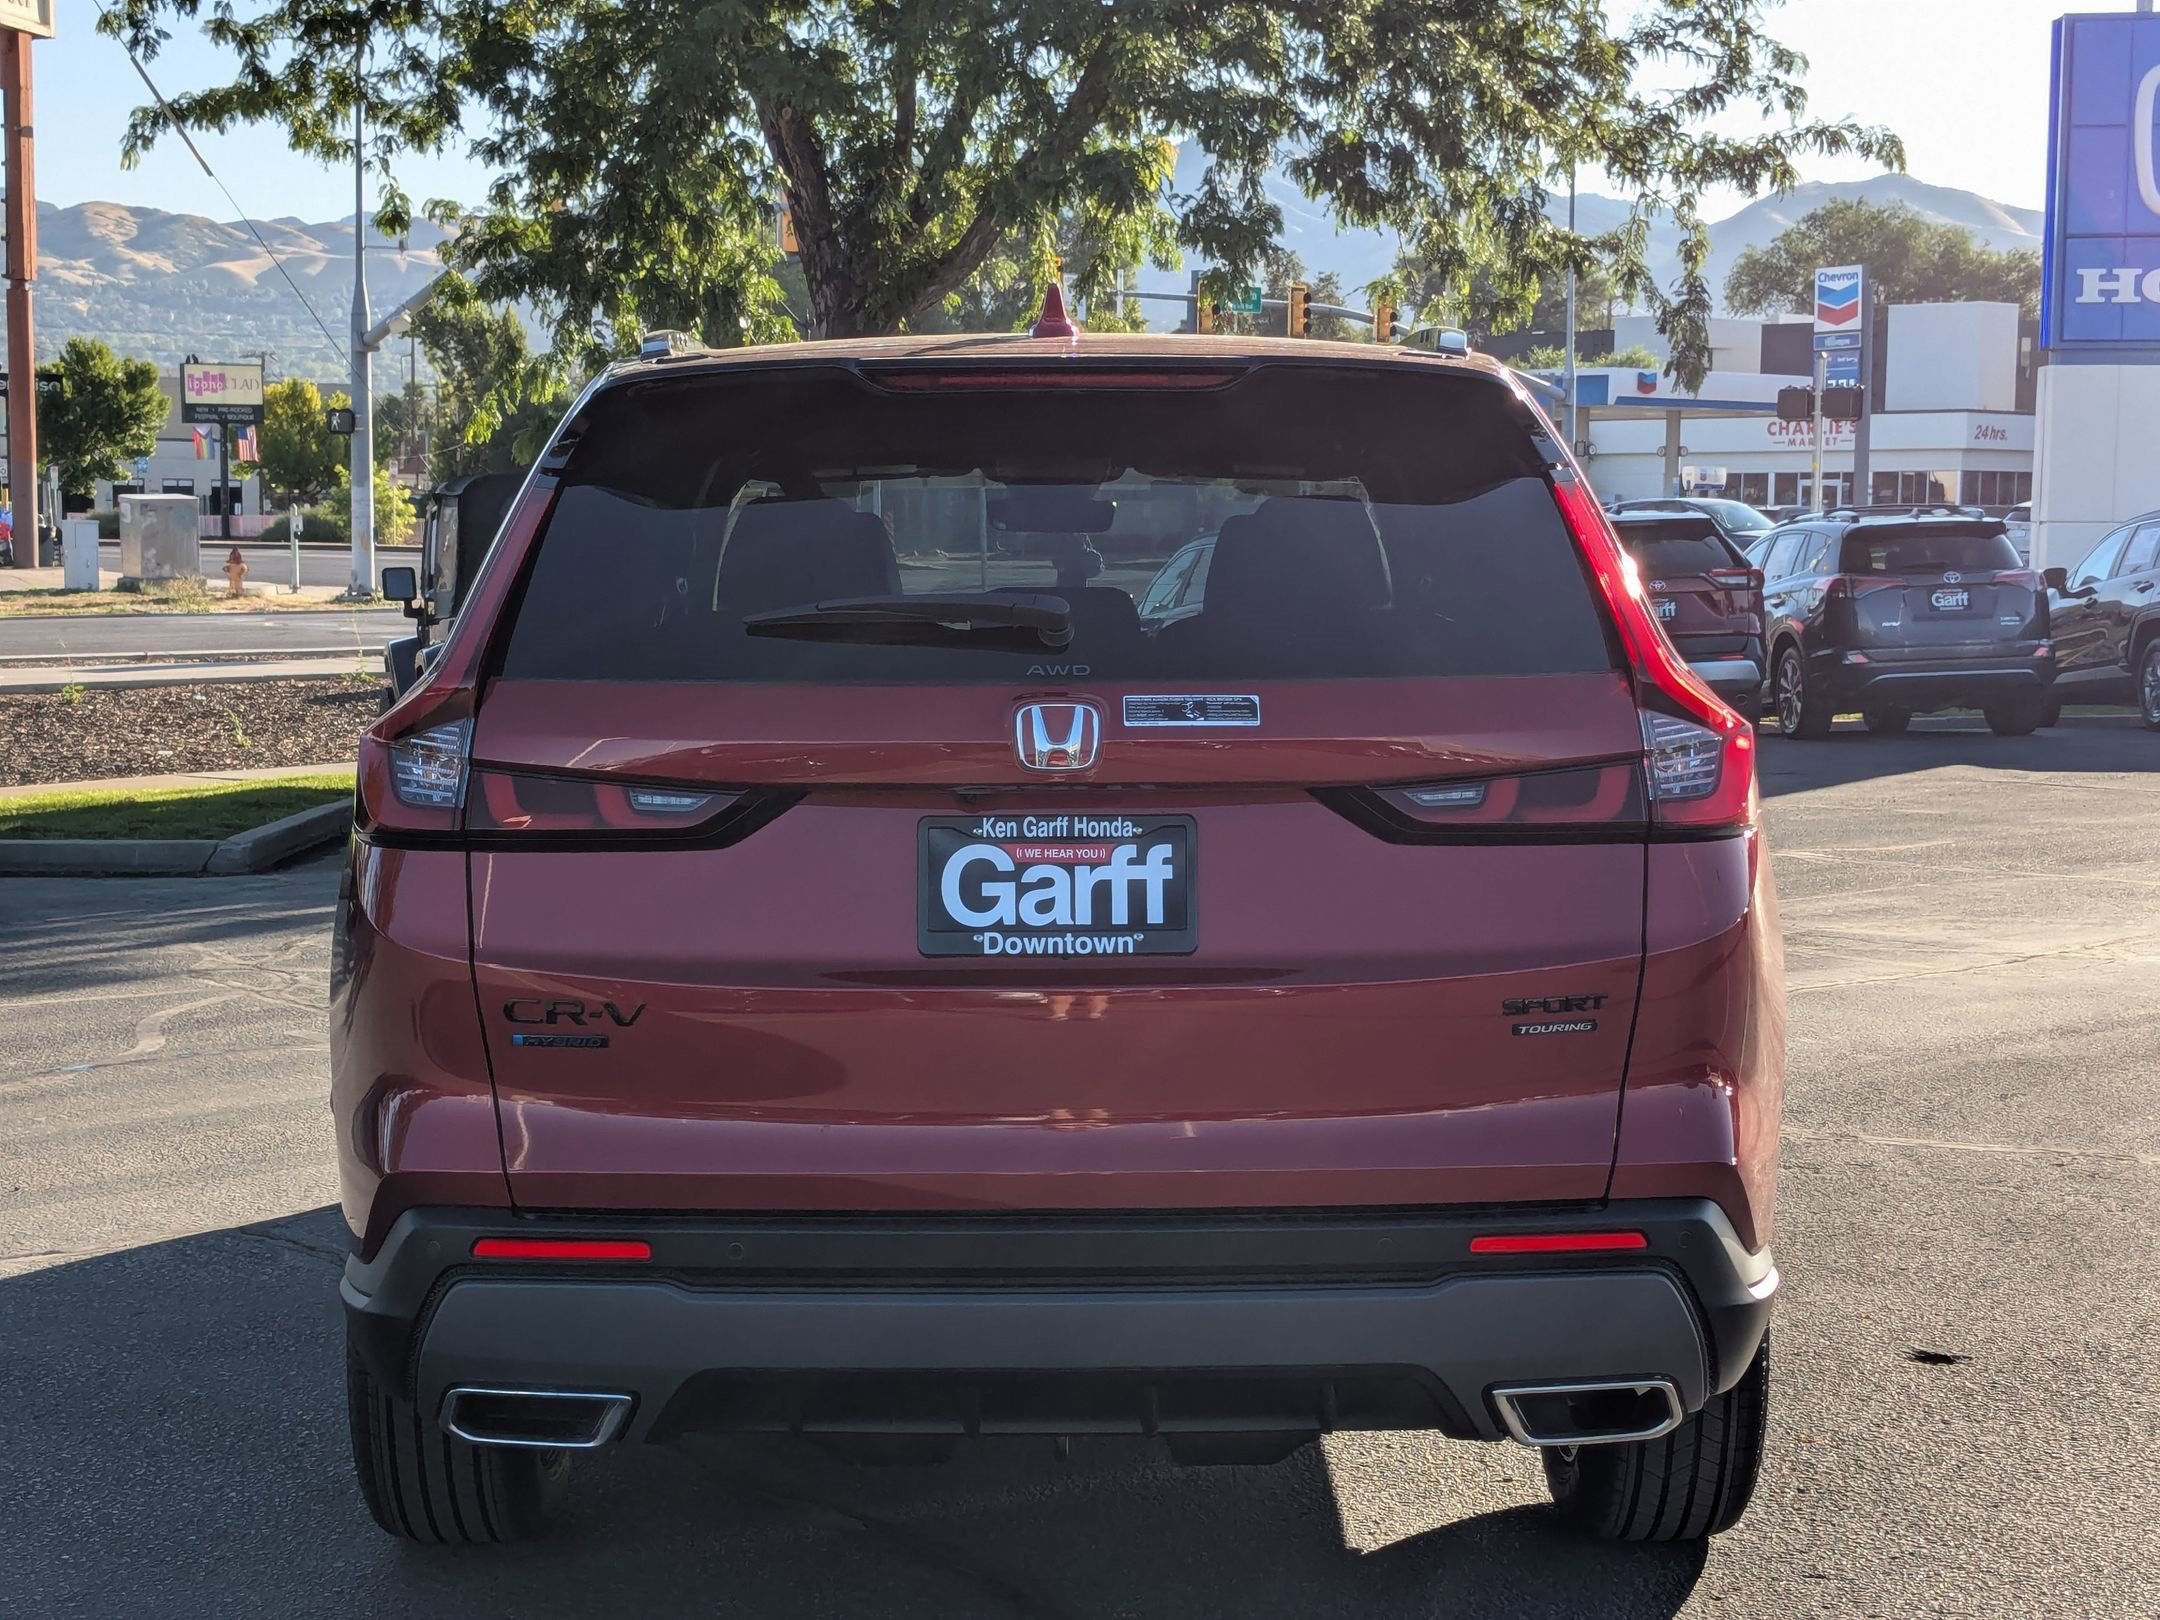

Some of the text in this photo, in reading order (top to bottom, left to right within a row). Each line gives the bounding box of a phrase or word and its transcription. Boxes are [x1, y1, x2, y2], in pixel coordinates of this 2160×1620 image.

[1818, 271, 1859, 283] Chevron
[1767, 418, 1856, 436] CHARIE'S
[1787, 437, 1838, 447] MARET
[1931, 591, 1969, 607] Garff
[1026, 664, 1091, 676] AWD
[982, 816, 1133, 838] Ken Garff Honda
[1025, 848, 1098, 858] WE HEAR YOU
[941, 844, 1173, 927] Garff
[983, 932, 1134, 954] Downtown
[503, 998, 647, 1027] CR-V
[1502, 993, 1608, 1016] SPORT
[1518, 1021, 1594, 1035] TOURING
[525, 1036, 602, 1047] HYBRID
